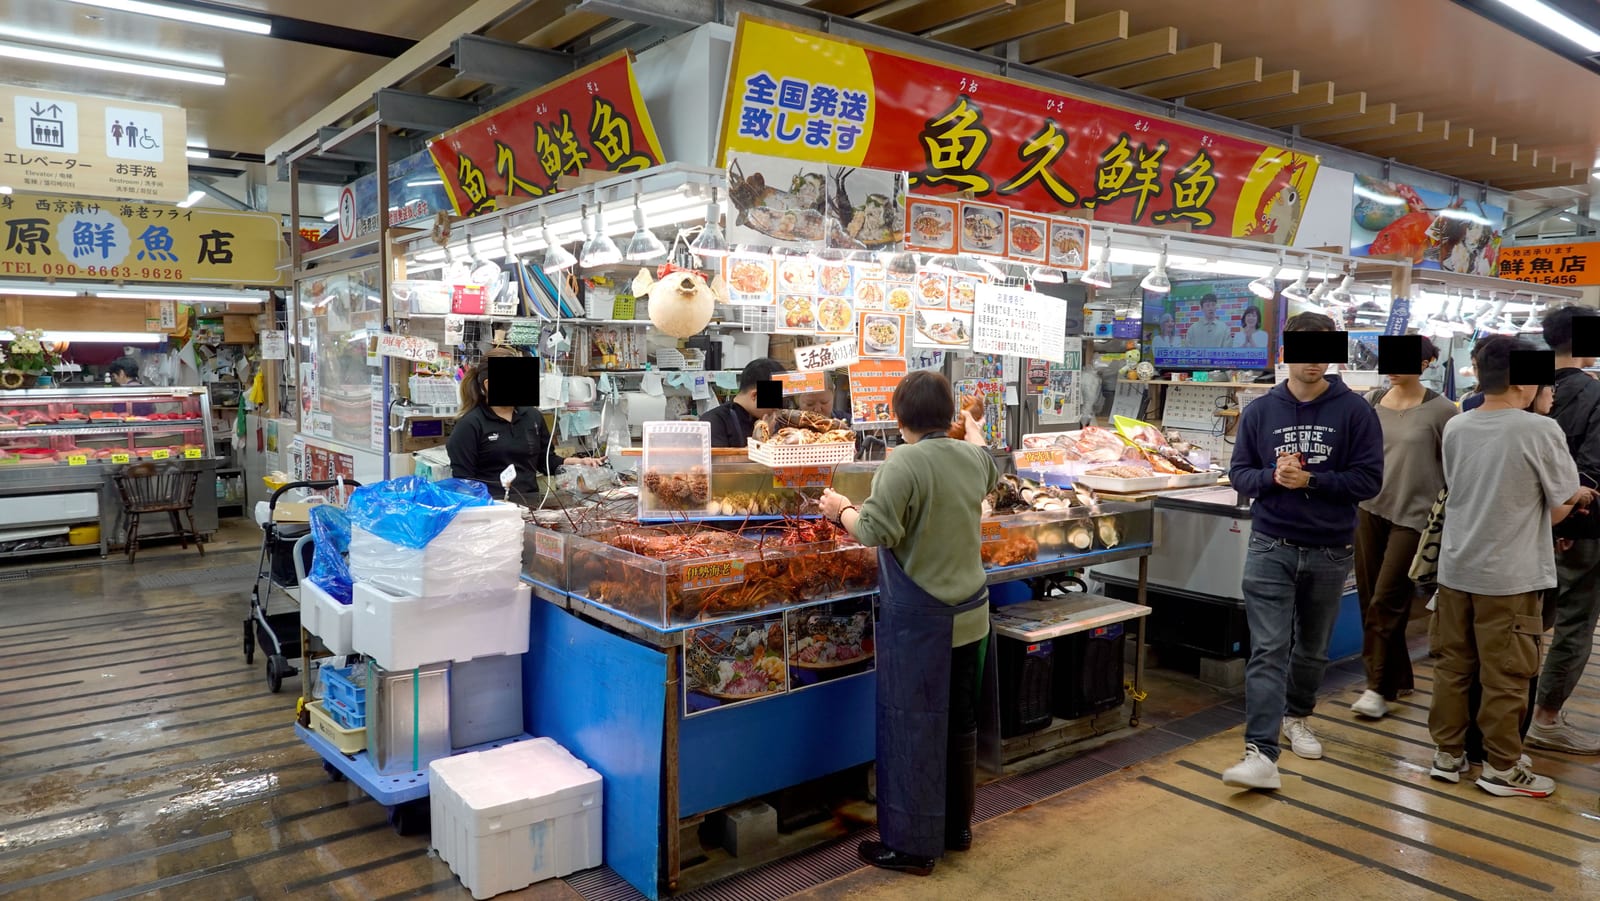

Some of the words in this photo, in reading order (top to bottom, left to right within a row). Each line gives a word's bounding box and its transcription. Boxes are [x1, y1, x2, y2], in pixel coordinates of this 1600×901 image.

[959, 77, 979, 94] うお
[744, 73, 868, 122] 全国発送
[1047, 99, 1064, 113] ひさ
[739, 106, 864, 151] 致します
[1134, 120, 1149, 132] せん
[4, 153, 92, 169] エレベーター
[458, 99, 651, 217] 魚久鮮魚
[903, 99, 1217, 226] 魚久鮮魚
[25, 170, 54, 178] Elevator
[116, 163, 157, 178] お手洗
[109, 177, 140, 185] Restroom
[36, 199, 100, 216] 西京漬け
[120, 205, 193, 222] 海老フライ
[2, 261, 36, 275] TEL
[43, 262, 183, 280] 090-8663-9626
[1500, 255, 1587, 276] 鮮魚店
[1284, 431, 1323, 443] SCENCE
[687, 562, 730, 580] 伊勢海老
